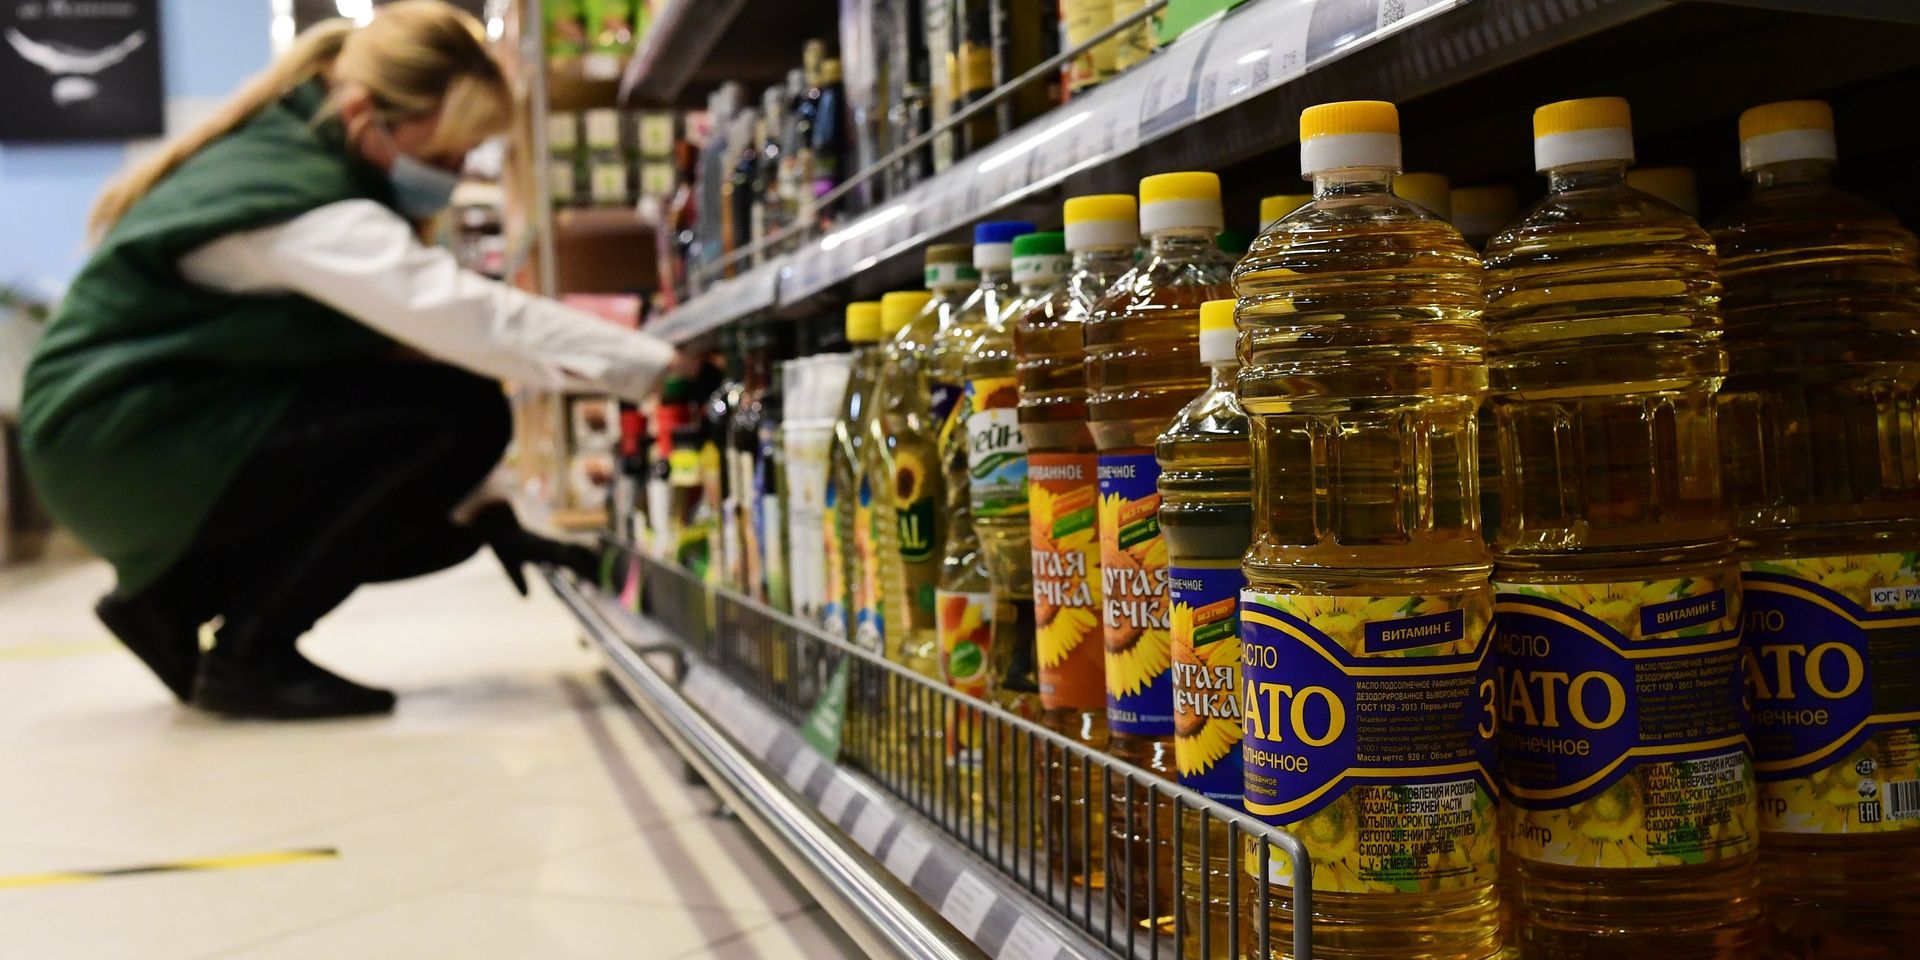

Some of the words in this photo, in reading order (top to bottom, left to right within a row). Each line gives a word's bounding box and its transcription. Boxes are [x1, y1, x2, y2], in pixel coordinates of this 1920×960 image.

[1874, 591, 1893, 603] ЮГ
[1656, 603, 1710, 625] ВИТАМИН
[1710, 599, 1718, 612] Е
[1382, 624, 1441, 642] ВИТАМИН
[1444, 621, 1452, 633] Е
[1356, 681, 1379, 691] МАСЛО
[1380, 679, 1430, 690] ПОДСОЛНЕЧНОЕ
[1636, 683, 1657, 694] ГОСТ
[1356, 691, 1424, 702] ДЕЗОДОРИРОВАННОЕ
[1356, 703, 1377, 712] ГОСТ
[1380, 703, 1396, 712] 1129
[1401, 702, 1418, 712] 2013
[1356, 753, 1381, 762] Масса
[1382, 754, 1406, 762] нетто:
[1407, 752, 1420, 762] 920
[1665, 761, 1719, 777] ИЗГОТОВЛЕНИЯ
[1359, 788, 1382, 801] ДАТА
[1382, 785, 1443, 800] ИЗГОТОВЛЕНИЯ
[1444, 785, 1450, 796] И
[1684, 788, 1704, 802] СРОК
[1358, 802, 1397, 815] УКАЗАНА
[1398, 802, 1404, 814] В
[1405, 799, 1440, 813] ВЕРХНЕЙ
[1440, 798, 1462, 811] ЧАСТИ
[1401, 814, 1423, 827] СРОК
[1423, 812, 1460, 827] ГОДНОСТИ
[1461, 810, 1472, 823] ПРИ
[1359, 829, 1424, 843] ИЗГОТОВЛЕНИИ
[1424, 823, 1476, 841] ПРЕДПРИЯТИЕМ
[1645, 820, 1652, 832] С
[1655, 832, 1661, 844] V
[1667, 831, 1675, 845] 12
[1359, 844, 1365, 857] С
[1399, 843, 1405, 856] R
[1411, 843, 1419, 856] 18
[1368, 857, 1375, 870] V
[1380, 857, 1389, 870] 12
